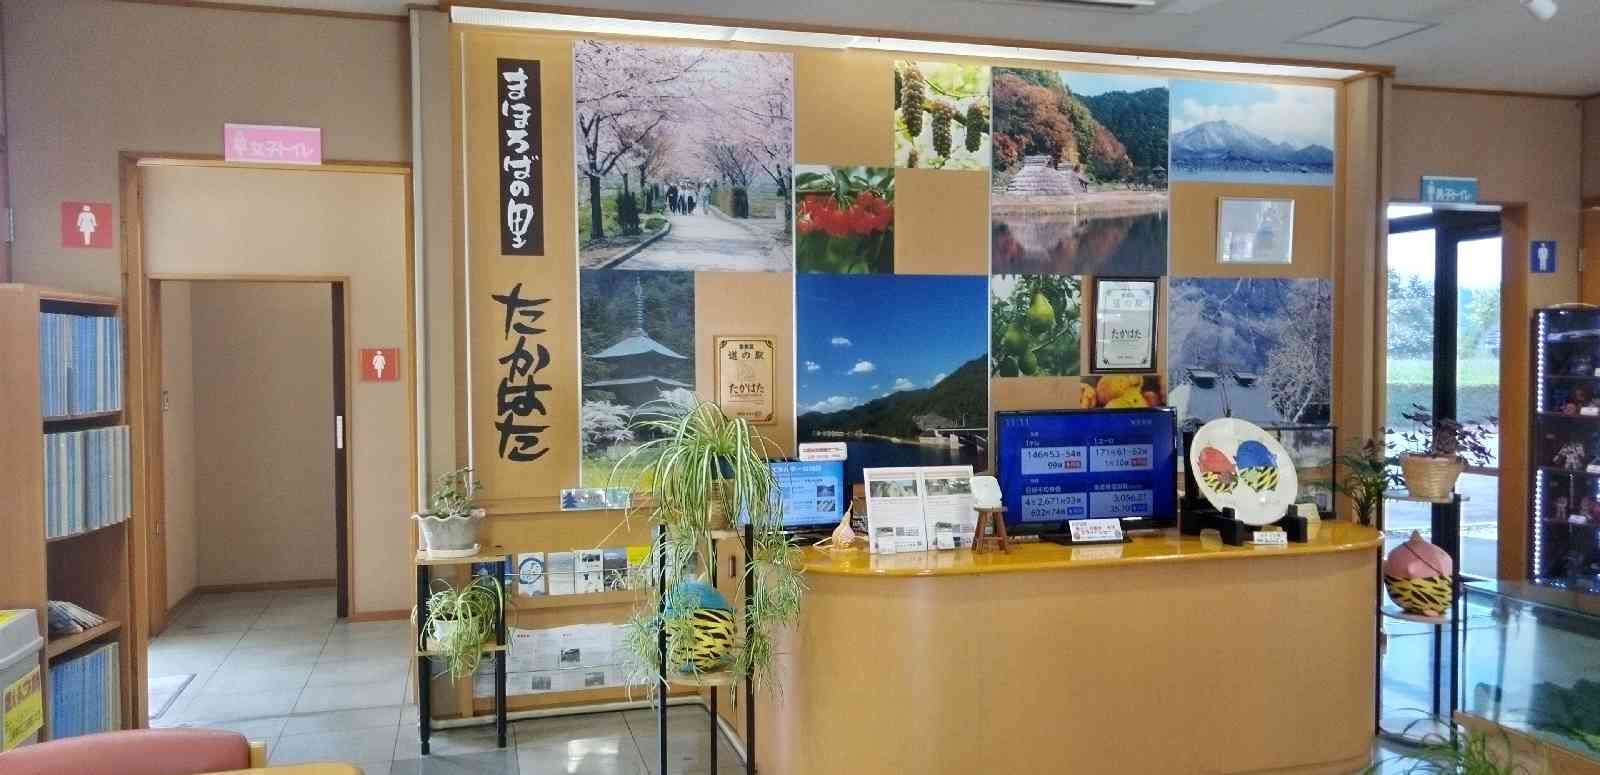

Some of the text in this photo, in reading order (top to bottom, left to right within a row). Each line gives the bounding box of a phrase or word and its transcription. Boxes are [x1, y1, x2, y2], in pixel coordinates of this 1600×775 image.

[246, 140, 315, 160] 女子トイレ
[502, 67, 539, 249] まほろばの里
[1112, 328, 1142, 339] たかはた
[728, 350, 764, 360] 道の駅
[491, 282, 553, 462] たかはた
[728, 383, 765, 394] たかはた
